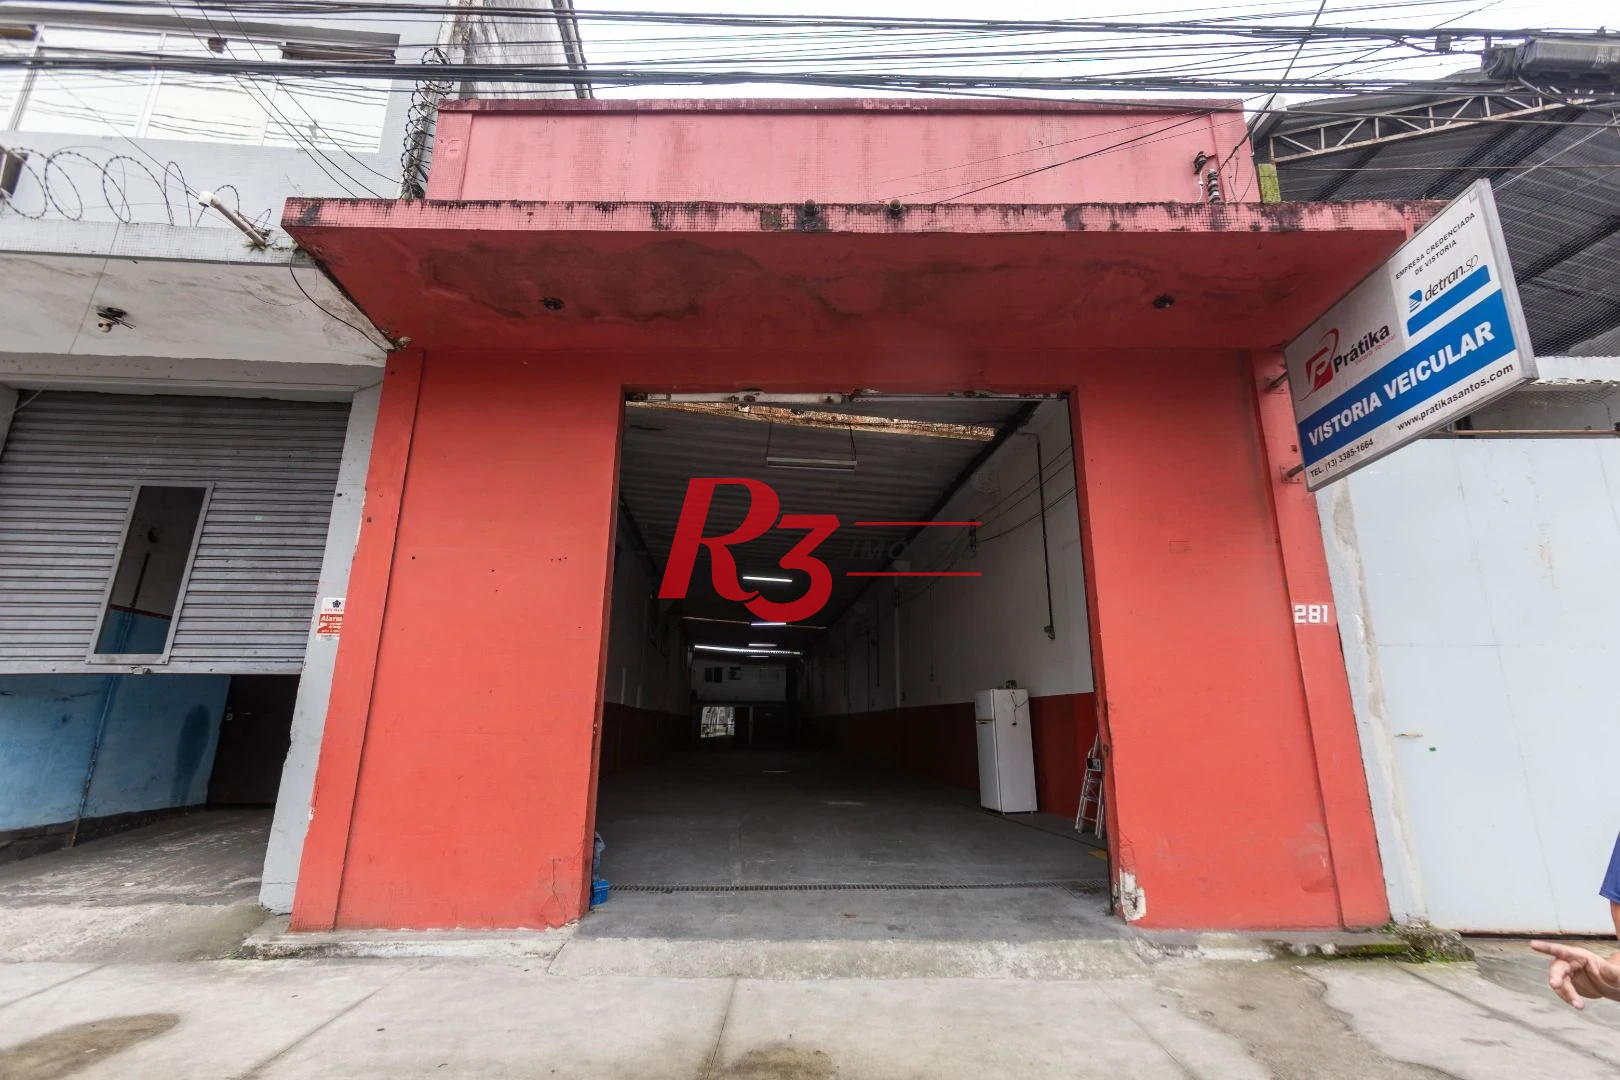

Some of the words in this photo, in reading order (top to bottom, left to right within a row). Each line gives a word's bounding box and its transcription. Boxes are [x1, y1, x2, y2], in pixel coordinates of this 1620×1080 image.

[1395, 253, 1425, 280] EMPRESA
[1425, 212, 1476, 255] CREDENCIADA
[1414, 265, 1424, 276] DE
[1424, 239, 1457, 267] VISTORIA
[1333, 325, 1391, 373] Prátika
[1308, 392, 1383, 446] VISTORIA
[1383, 321, 1496, 400] VEICULAR
[1396, 363, 1514, 431] www.pratikasantos.com
[1310, 466, 1325, 478] TEL.
[1294, 604, 1329, 624] 281
